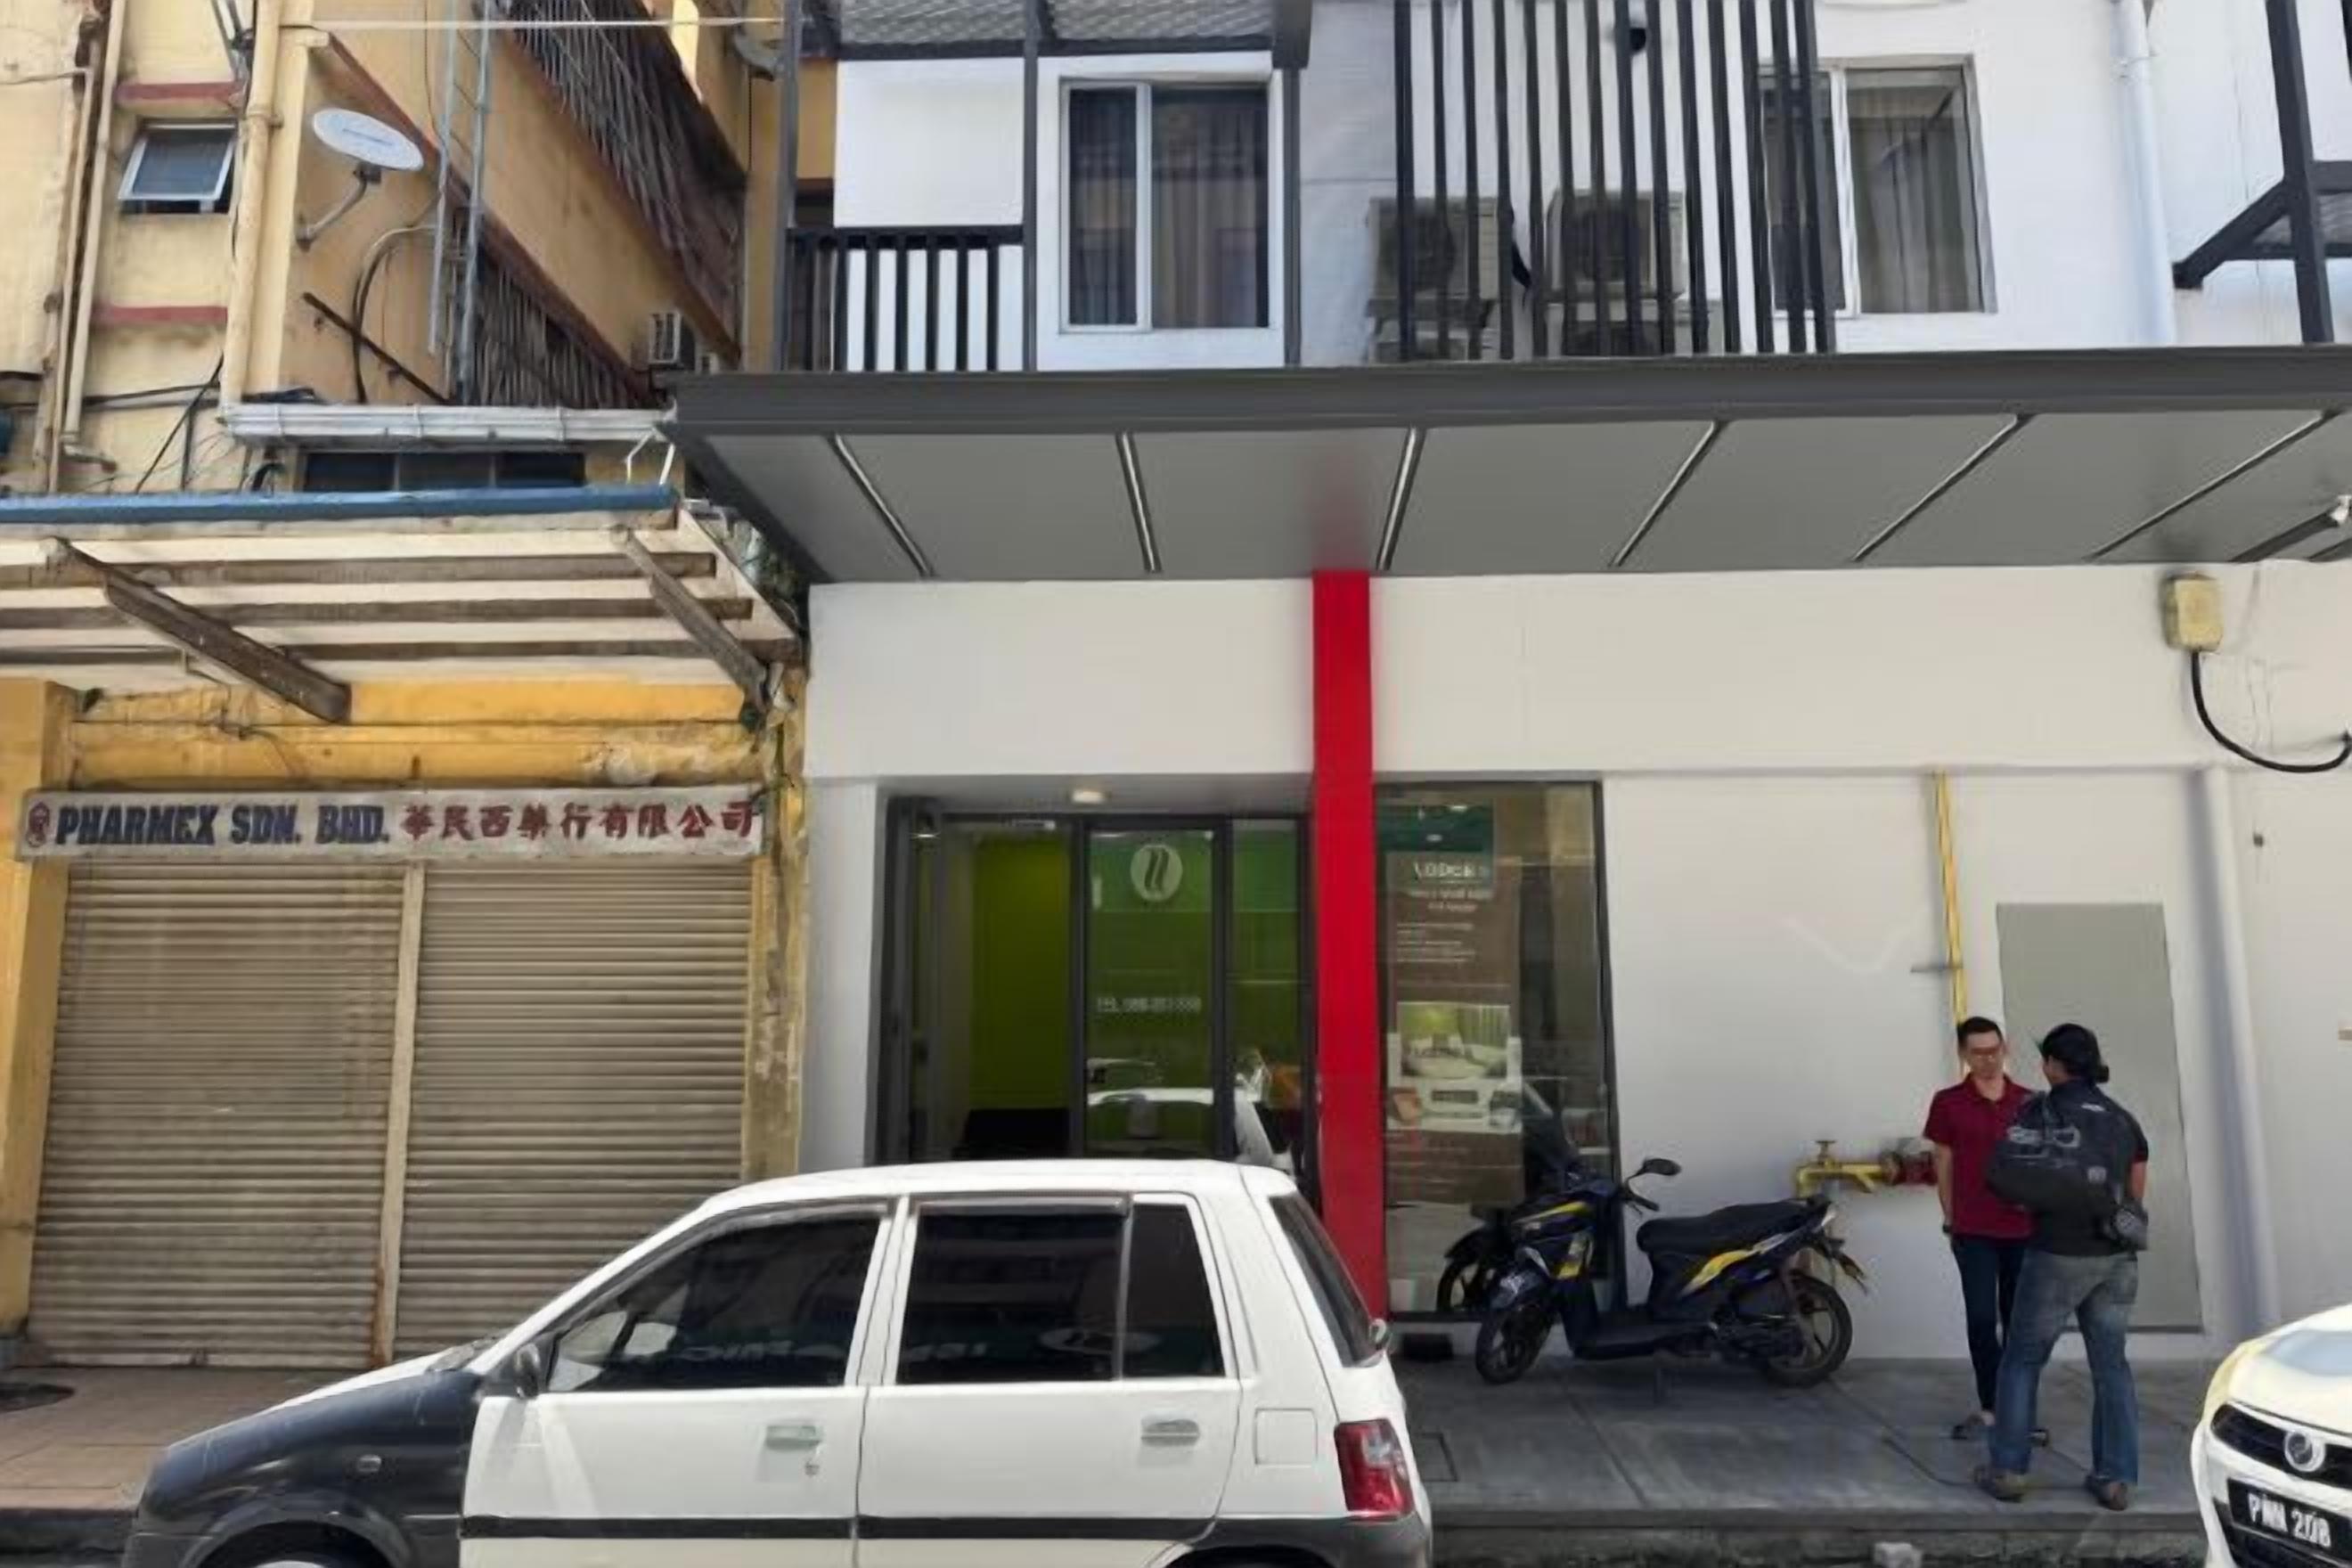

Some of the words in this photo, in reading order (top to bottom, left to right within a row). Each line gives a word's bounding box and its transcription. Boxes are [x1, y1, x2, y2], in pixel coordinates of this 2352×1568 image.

[55, 804, 219, 845] PHARMEX
[230, 804, 301, 844] SDN.
[314, 804, 390, 844] BHD.
